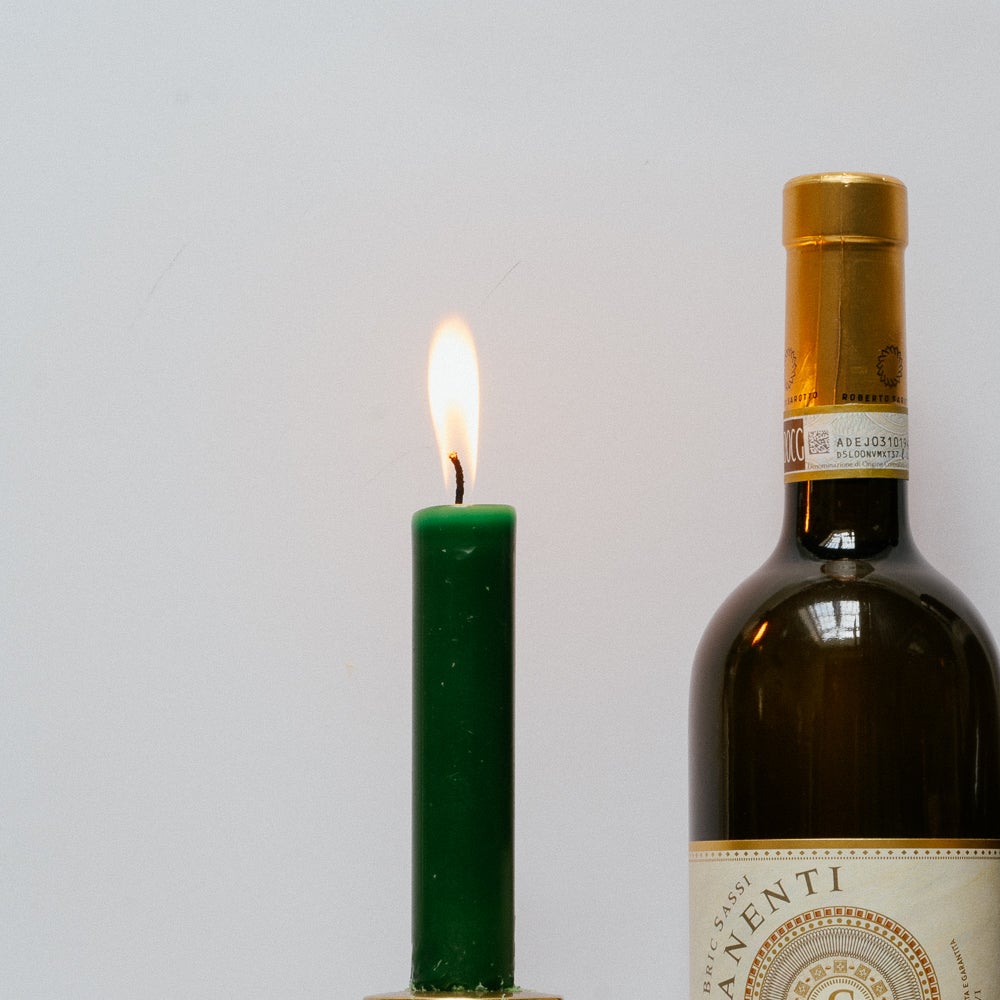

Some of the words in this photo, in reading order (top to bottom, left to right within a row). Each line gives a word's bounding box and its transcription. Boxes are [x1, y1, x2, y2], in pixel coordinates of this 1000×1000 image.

[842, 393, 889, 403] ROBERTO
[703, 937, 718, 994] BRIC
[714, 875, 753, 932] SASSI
[950, 938, 969, 982] GARANTITA
